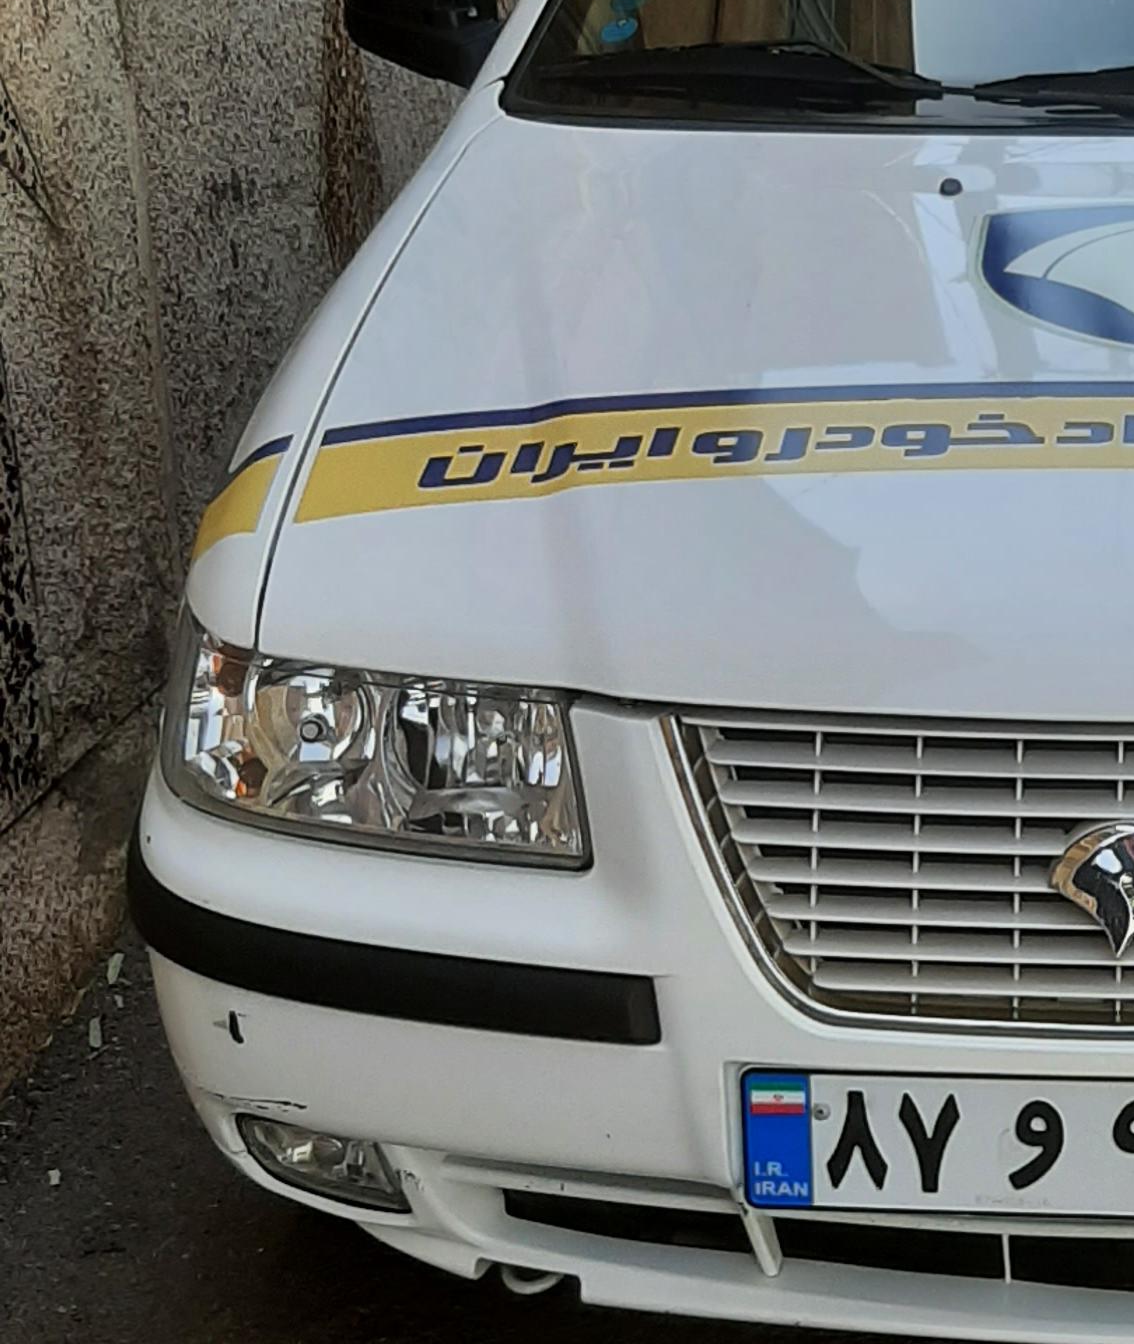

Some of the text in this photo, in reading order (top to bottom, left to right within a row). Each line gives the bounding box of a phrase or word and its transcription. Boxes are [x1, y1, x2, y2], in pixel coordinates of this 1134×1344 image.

[417, 426, 681, 488] ایران
[692, 413, 1046, 465] خودرو
[754, 1181, 808, 1197] IRAN
